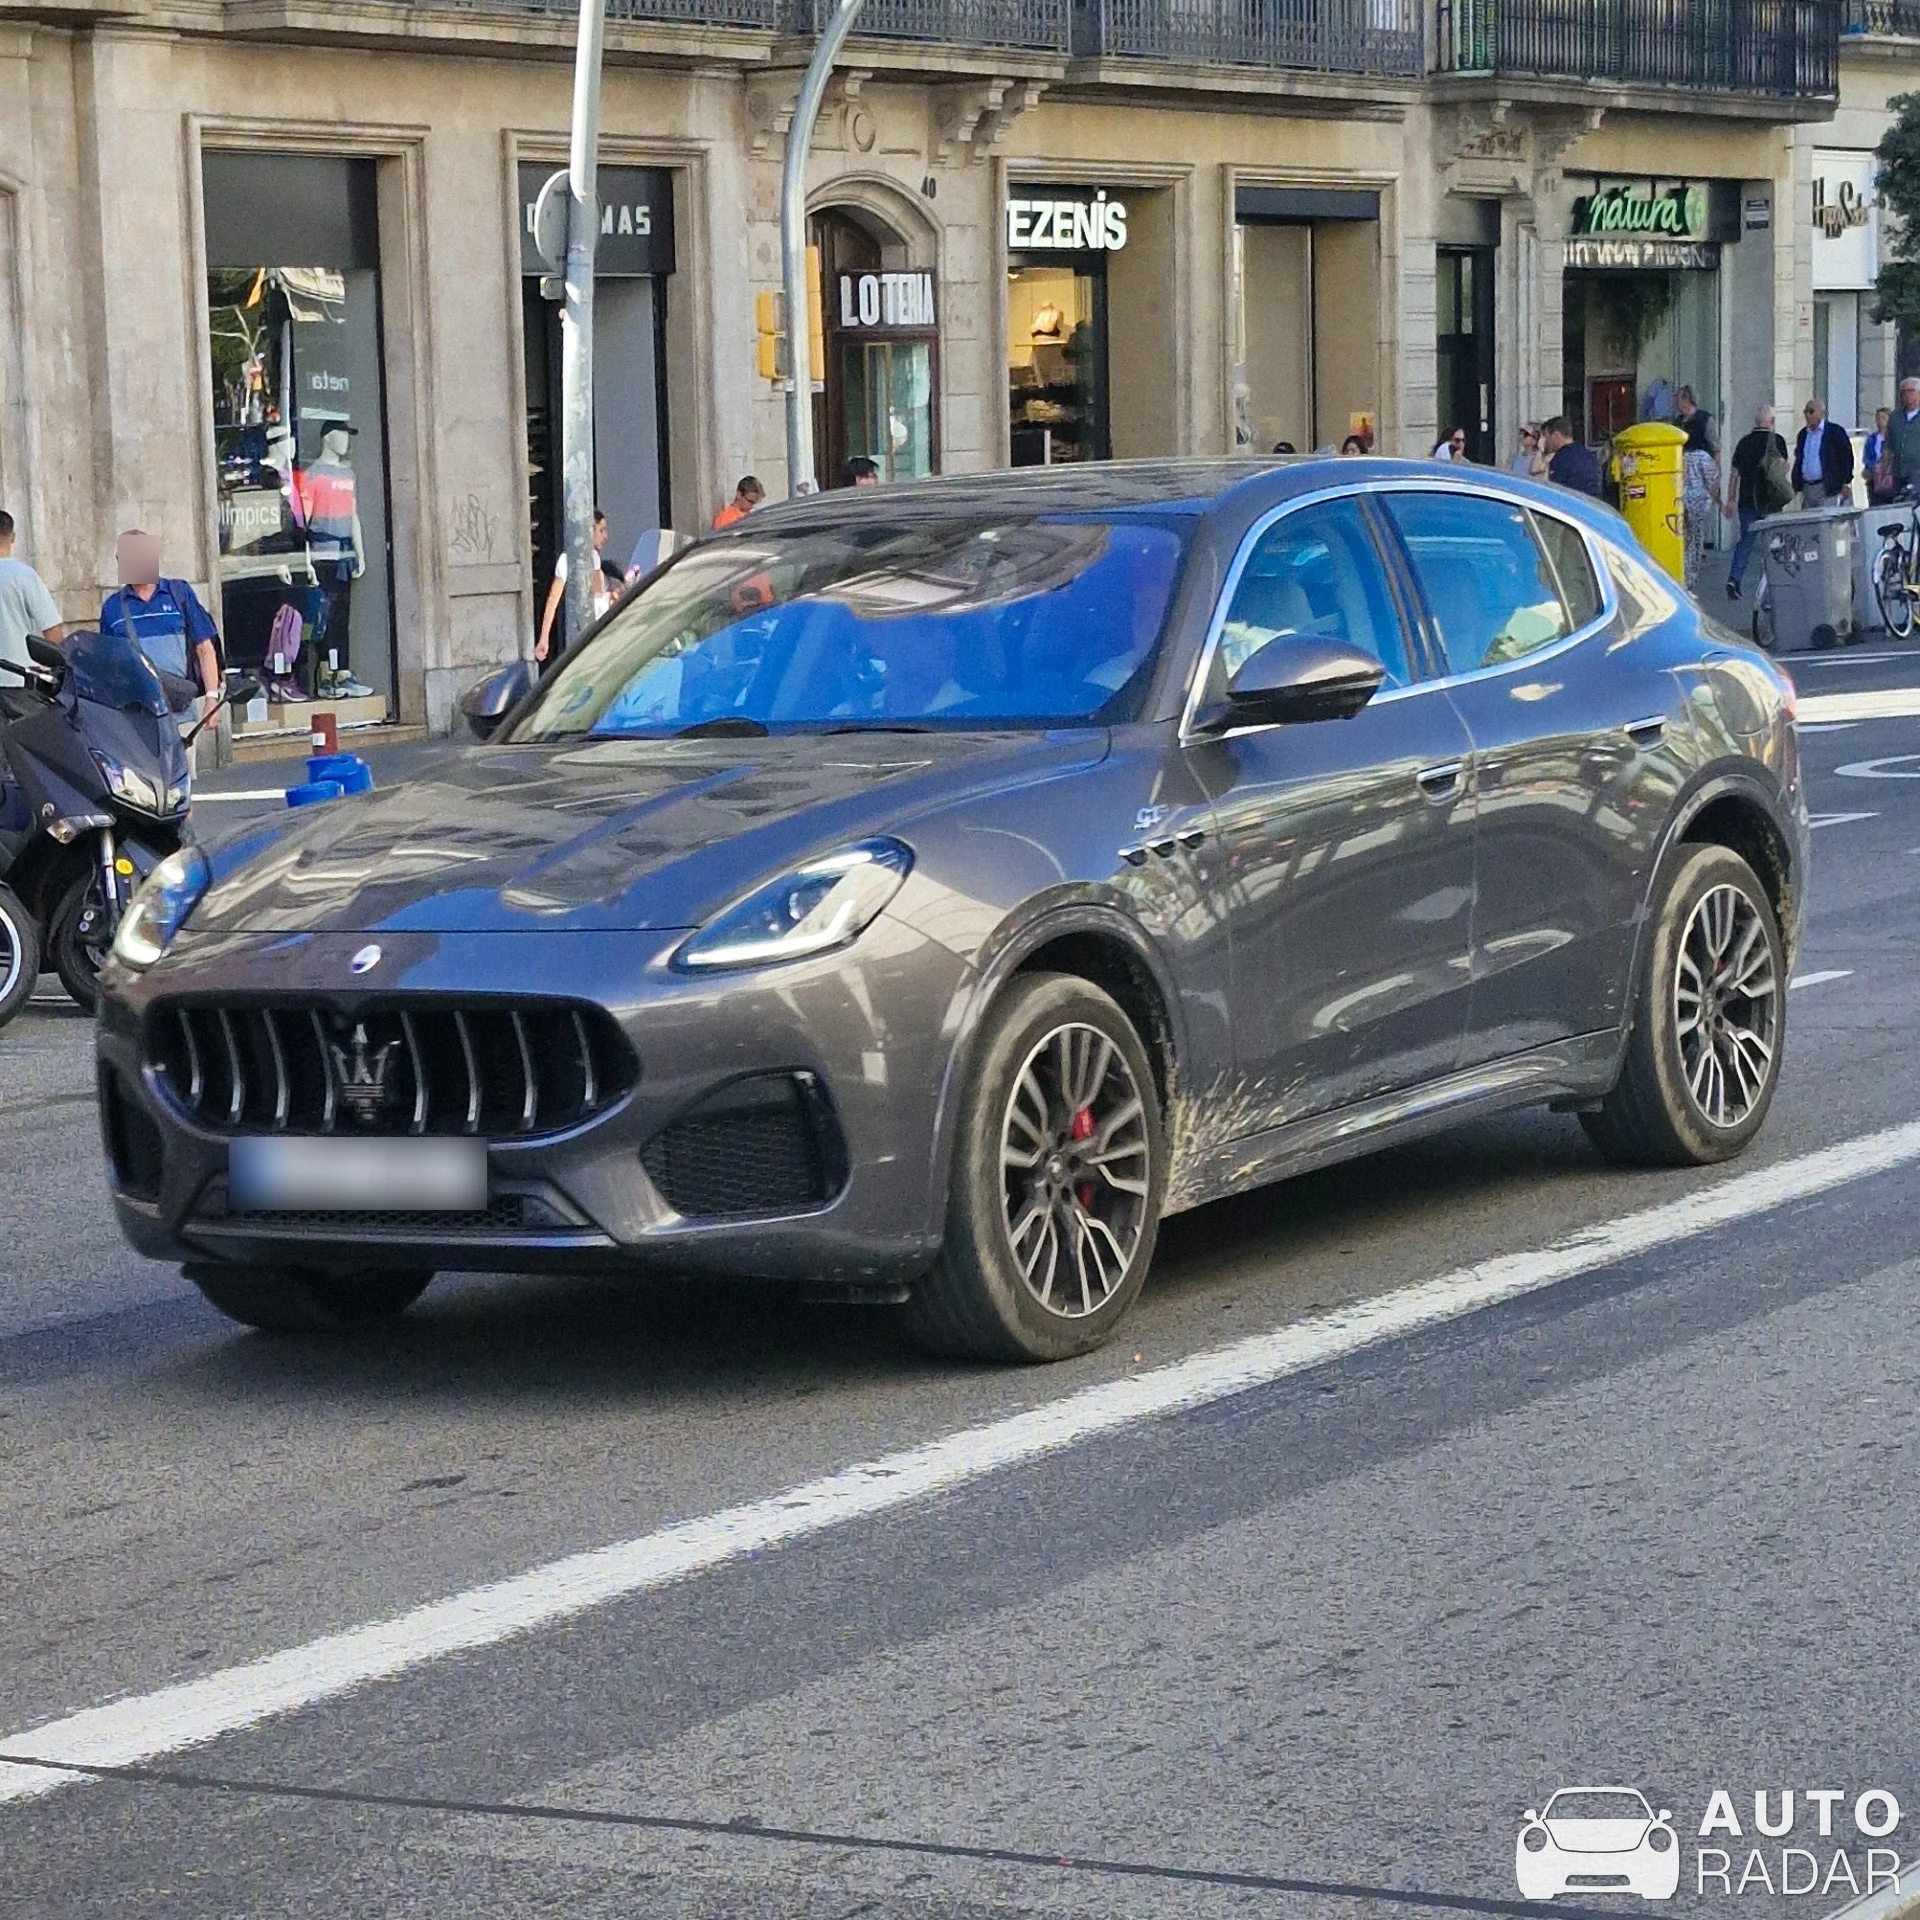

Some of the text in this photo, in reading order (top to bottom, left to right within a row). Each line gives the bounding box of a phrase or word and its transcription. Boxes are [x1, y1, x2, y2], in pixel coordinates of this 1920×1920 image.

[920, 176, 937, 199] 40
[1589, 190, 1684, 234] natura
[840, 273, 935, 327] LOTERIA
[218, 501, 280, 533] limpics
